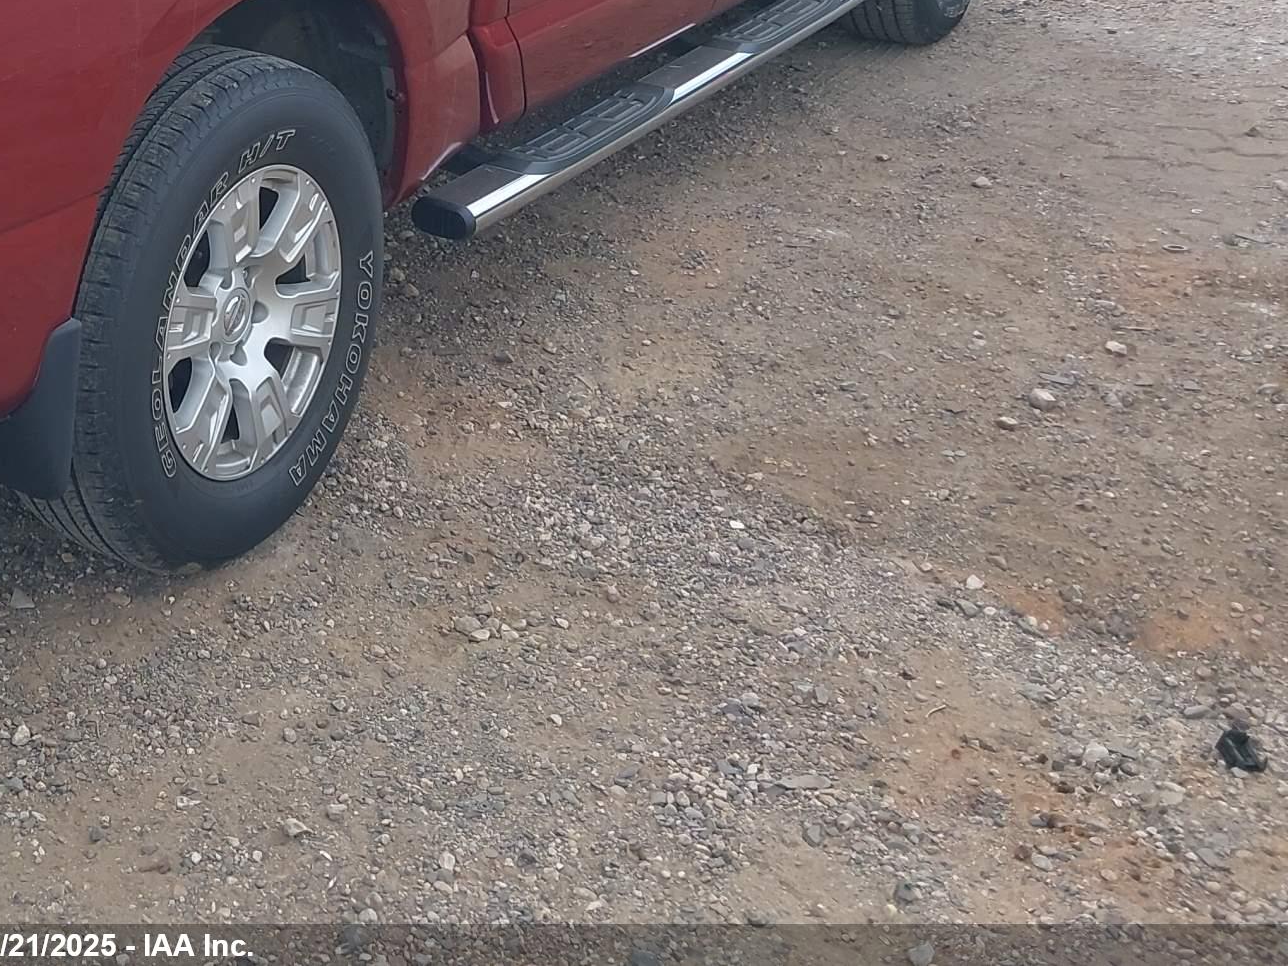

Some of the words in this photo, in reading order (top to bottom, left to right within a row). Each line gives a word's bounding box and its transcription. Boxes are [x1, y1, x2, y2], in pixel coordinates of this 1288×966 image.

[150, 170, 229, 479] GEOLANDAR
[237, 128, 297, 176] H/T
[288, 249, 374, 487] YOKOHAMA
